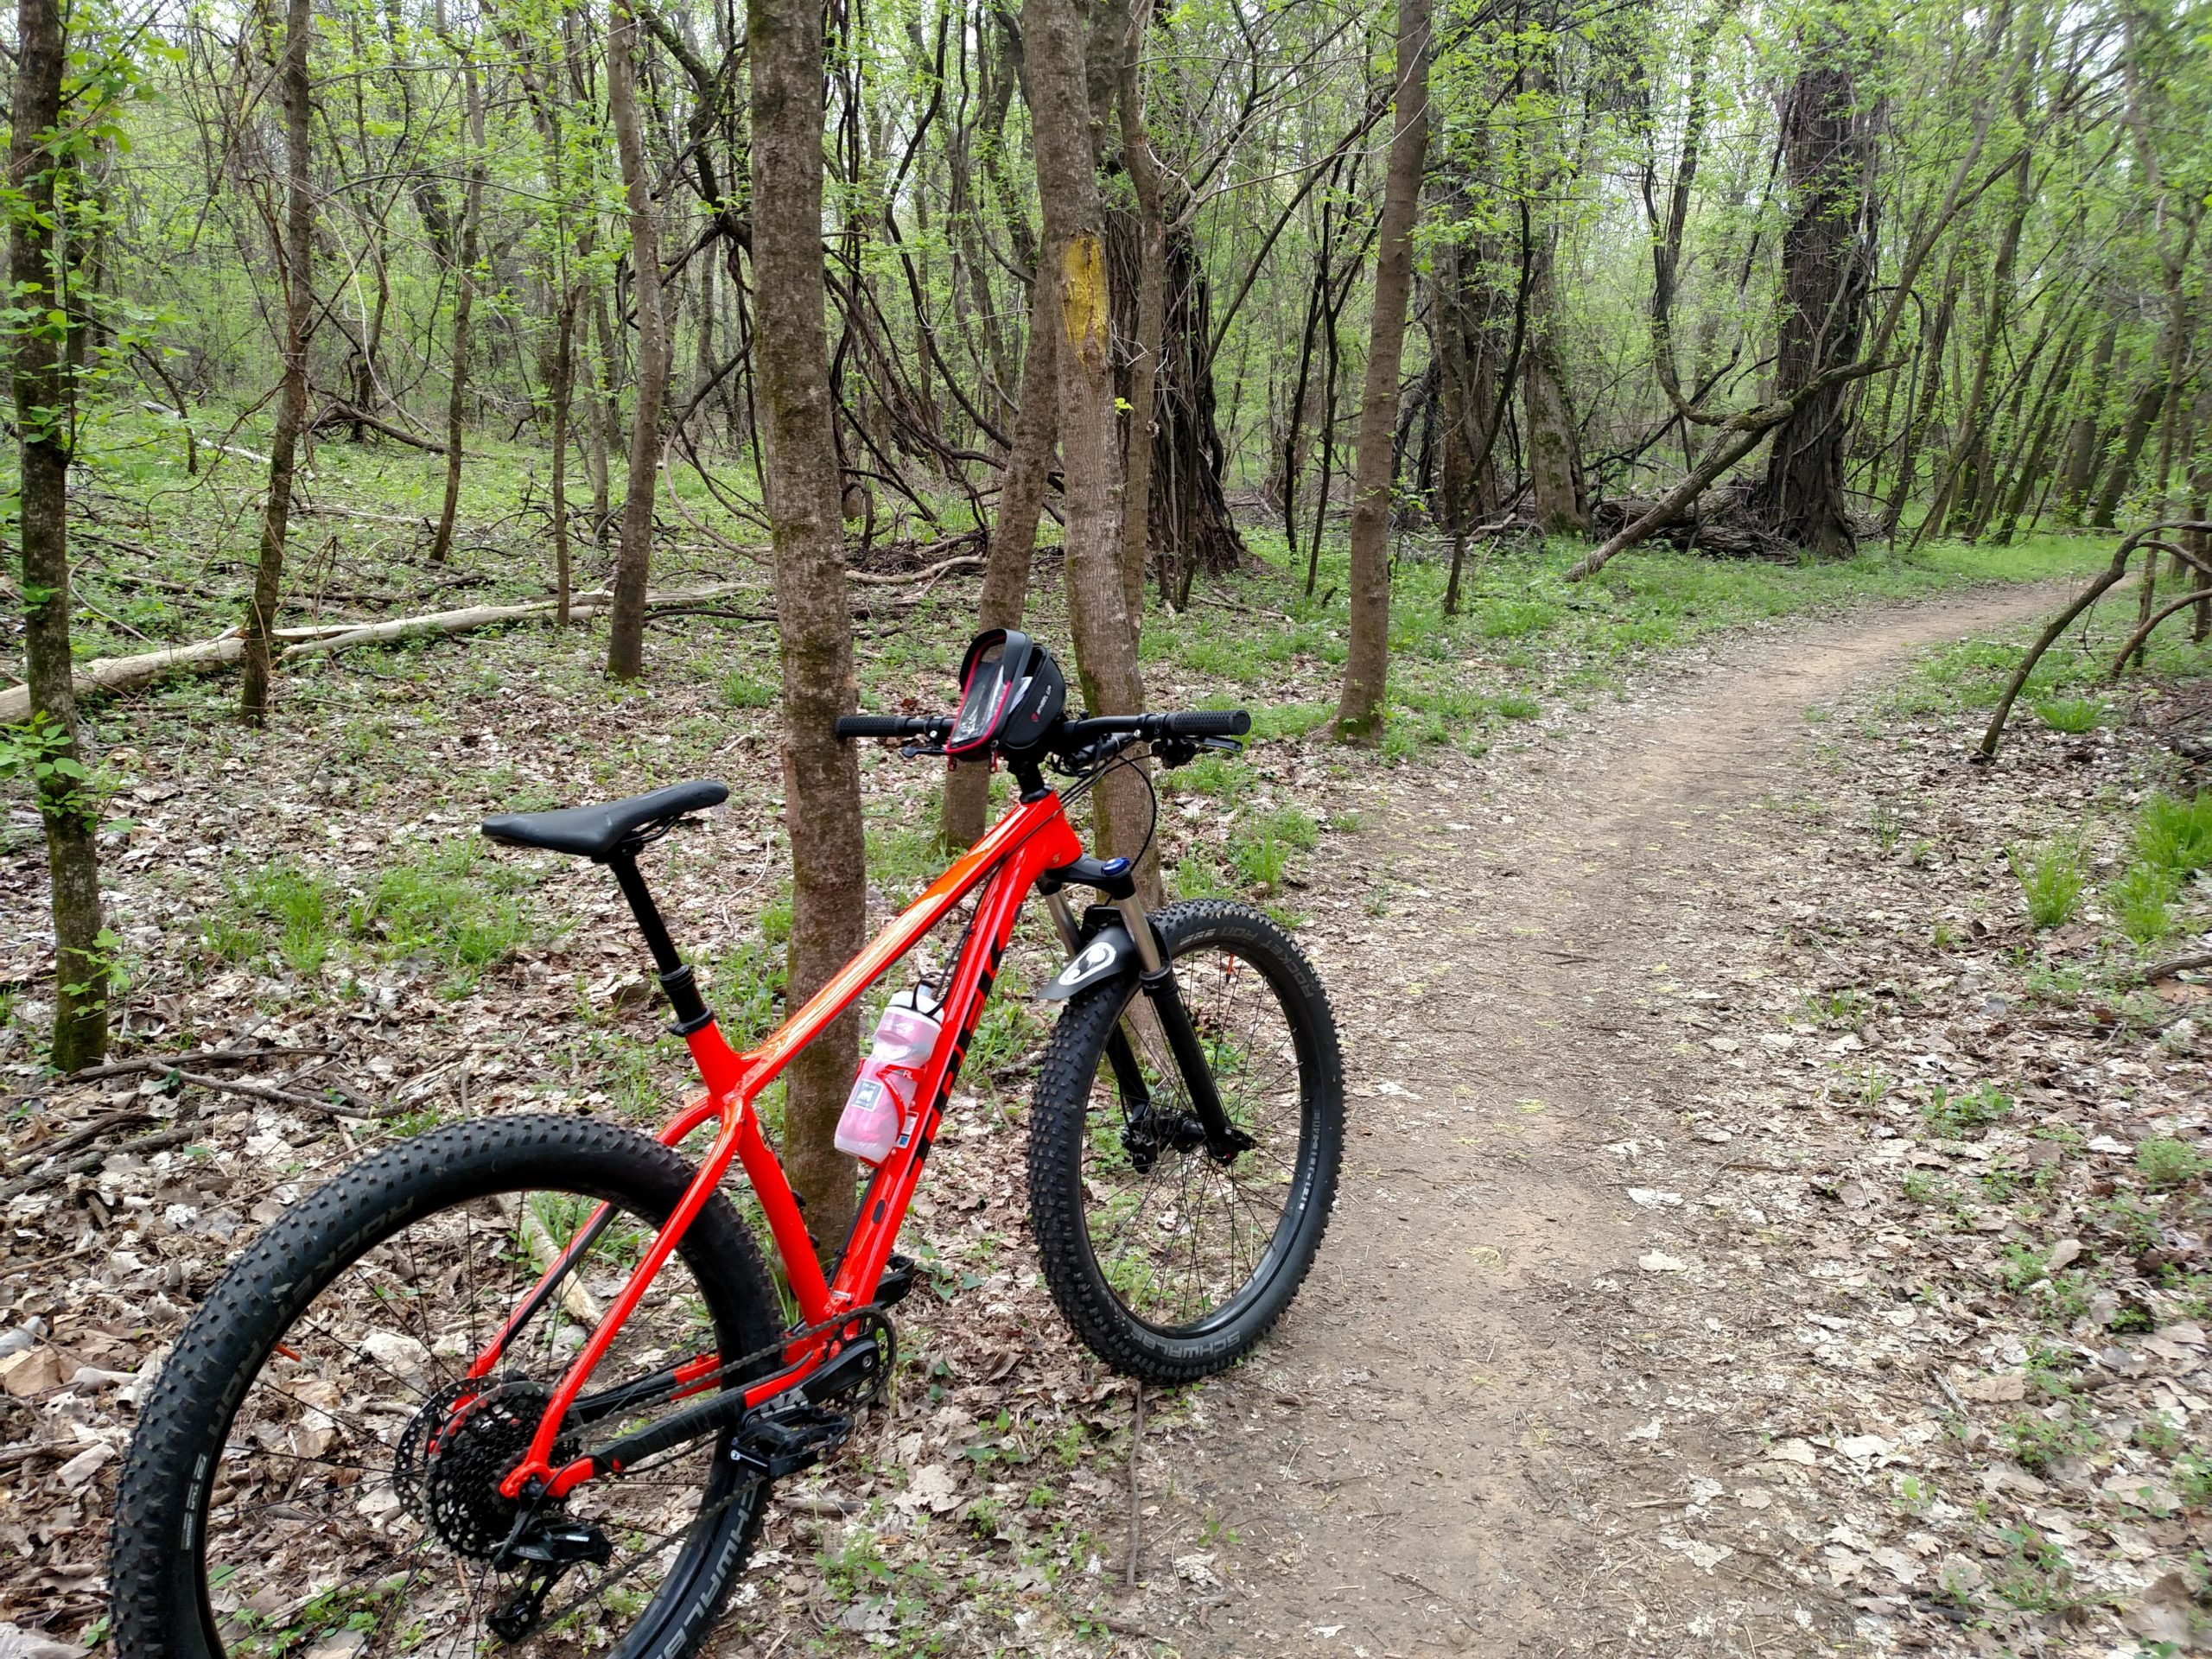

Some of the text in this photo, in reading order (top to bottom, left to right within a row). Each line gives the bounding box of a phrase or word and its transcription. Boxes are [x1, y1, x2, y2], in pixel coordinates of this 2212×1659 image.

[1220, 926, 1258, 941] RON
[1259, 939, 1314, 999] ROCKET
[907, 931, 1005, 1176] TREK
[1130, 1325, 1241, 1359] SCHWALBE
[655, 1469, 766, 1659] CHWALB
